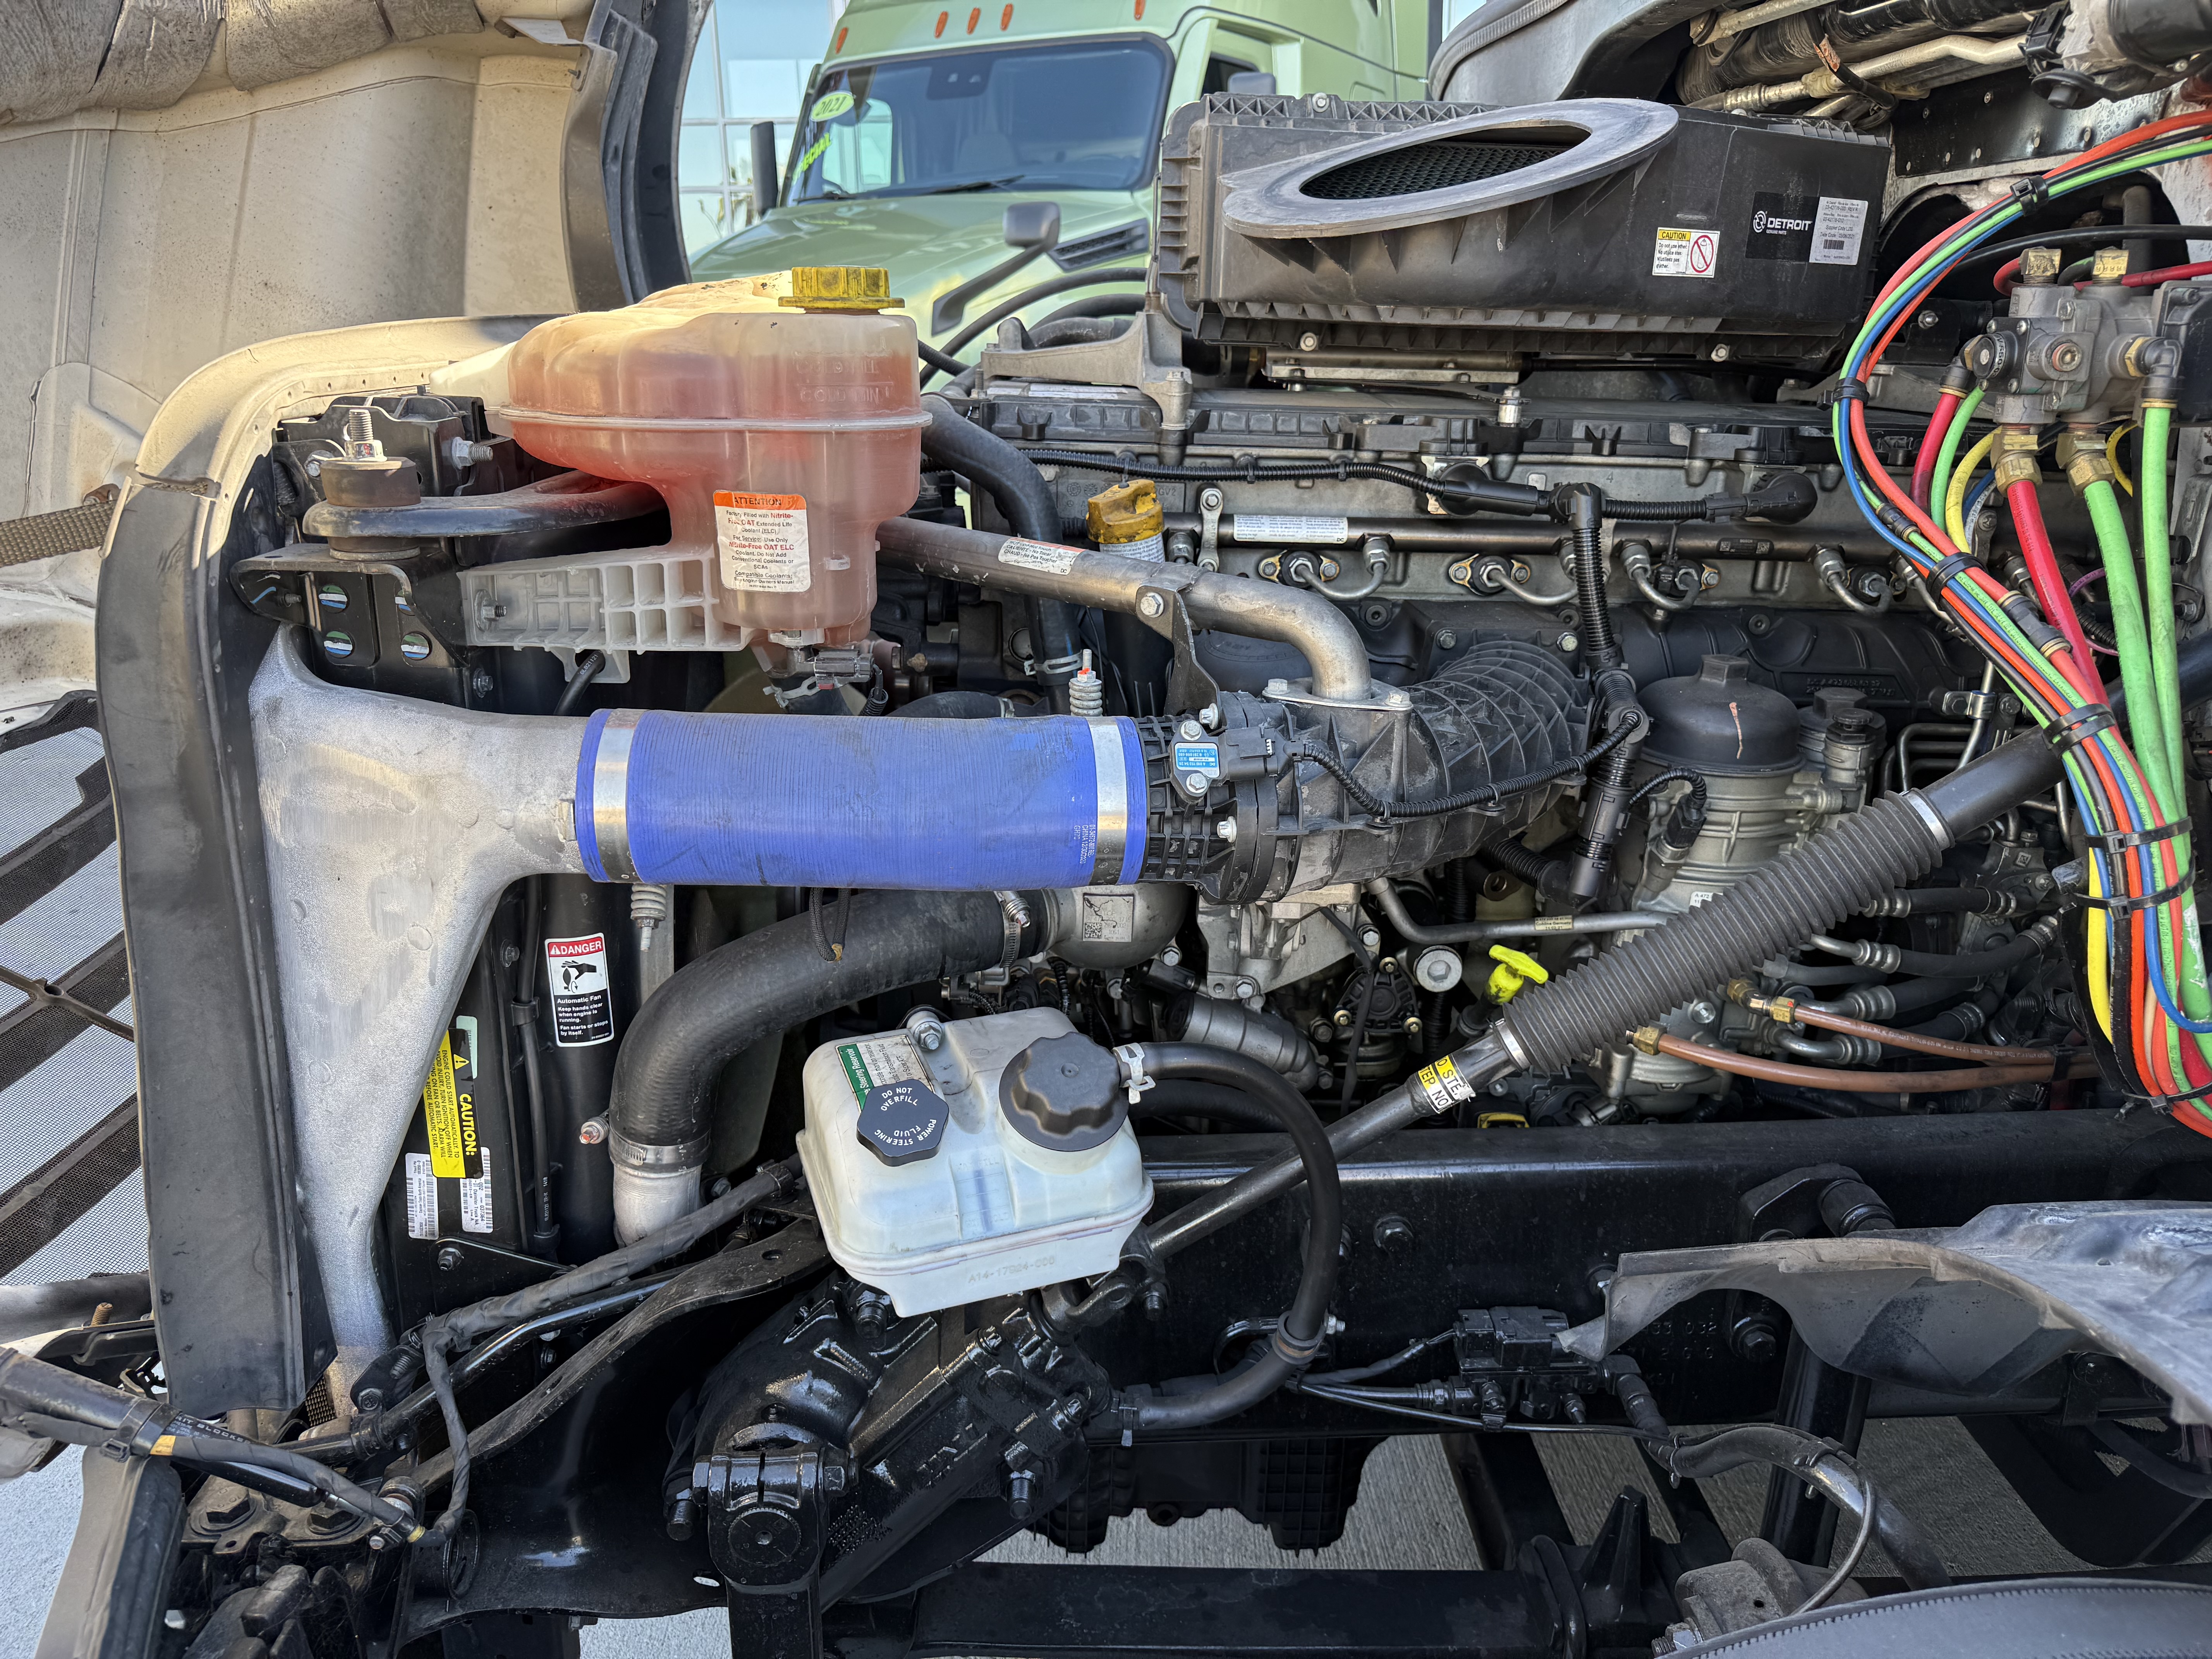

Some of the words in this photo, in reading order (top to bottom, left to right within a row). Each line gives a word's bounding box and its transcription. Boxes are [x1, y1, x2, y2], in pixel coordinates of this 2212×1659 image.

[815, 96, 847, 116] 2021
[1767, 218, 1811, 230] DETROIT
[561, 941, 601, 955] DANGER
[847, 1048, 863, 1070] Reservoir
[432, 1078, 438, 1087] ON
[856, 1068, 869, 1089] Steering
[1420, 1067, 1436, 1084] TEP
[1432, 1090, 1448, 1106] NO
[1443, 1070, 1462, 1095] STE
[881, 1096, 918, 1111] OVERFILL
[882, 1090, 893, 1099] DO
[428, 1102, 436, 1132] AUTOMATIC
[460, 1094, 477, 1156] CAUTION:
[449, 1108, 459, 1149] AUTOMATICALLY.
[454, 1150, 459, 1158] TO
[874, 1130, 914, 1146] STEERING
[894, 1125, 921, 1137] FLUID
[918, 1119, 936, 1141] POWER
[197, 1423, 251, 1444] BLOCKER
